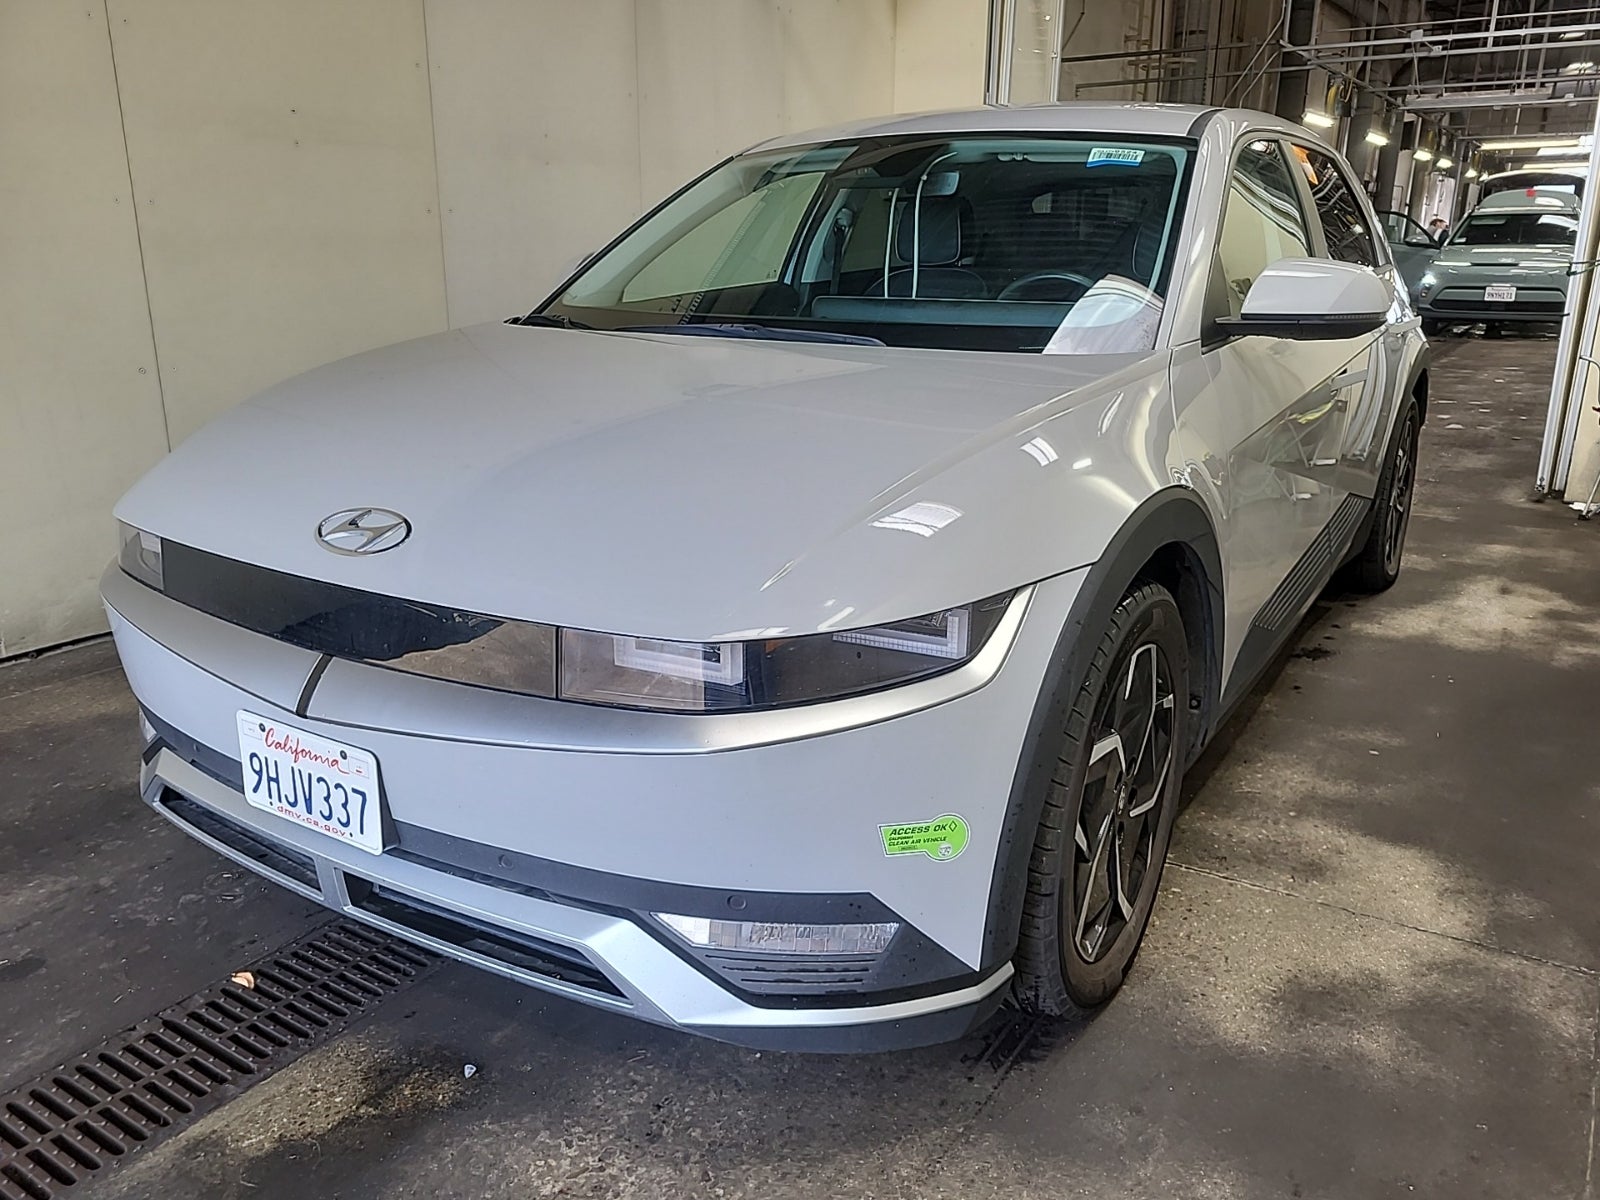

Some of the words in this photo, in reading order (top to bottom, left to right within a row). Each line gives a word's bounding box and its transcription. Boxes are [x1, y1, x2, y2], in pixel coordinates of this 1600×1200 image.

[265, 727, 349, 774] California
[249, 752, 367, 835] 9HJV337
[277, 805, 346, 837] dmv.ca.gov
[889, 825, 930, 836] ACCESS
[933, 823, 948, 832] OK
